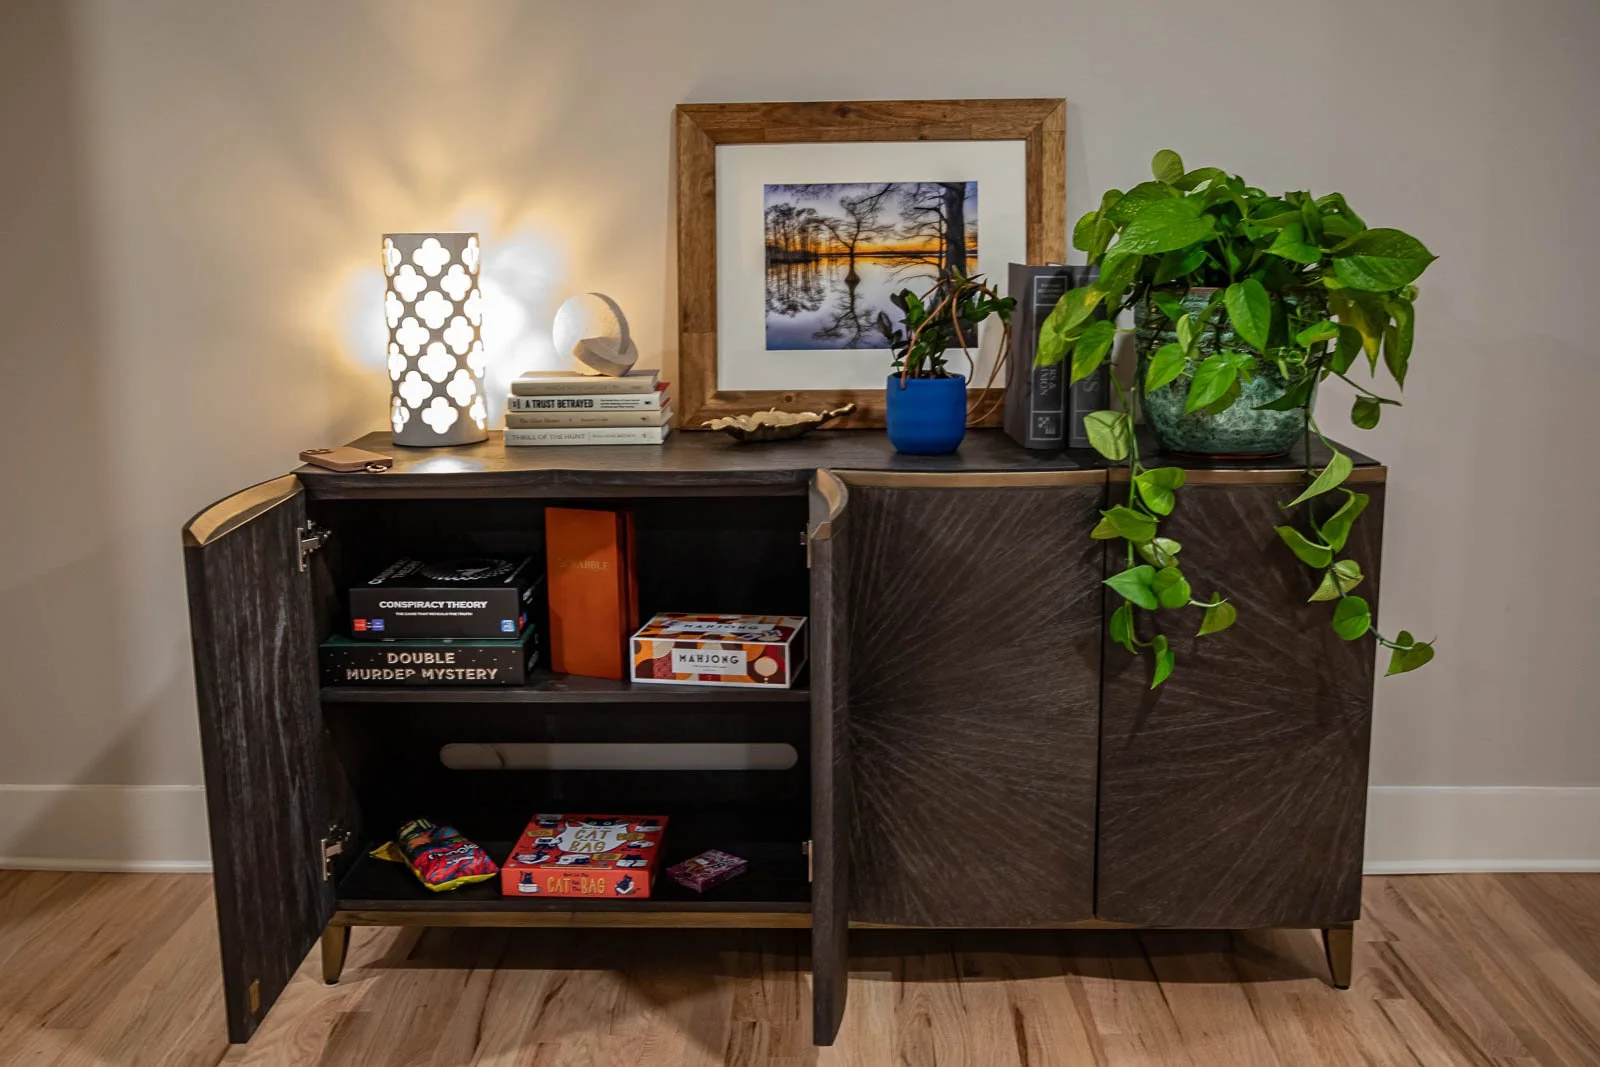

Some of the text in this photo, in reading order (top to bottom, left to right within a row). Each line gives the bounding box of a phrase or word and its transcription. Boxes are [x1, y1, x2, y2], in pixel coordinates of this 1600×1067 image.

[525, 399, 531, 409] A
[532, 399, 555, 409] TRUST
[557, 398, 594, 408] BETRAYED
[379, 601, 488, 609] CONSPIRACY THEORY
[387, 653, 455, 664] DOUBLE
[679, 654, 739, 664] MAHJONG
[422, 669, 498, 680] MYSTERY
[575, 829, 612, 839] CAT
[568, 841, 606, 851] BAG
[547, 876, 571, 893] CAT
[581, 877, 606, 894] BAG
